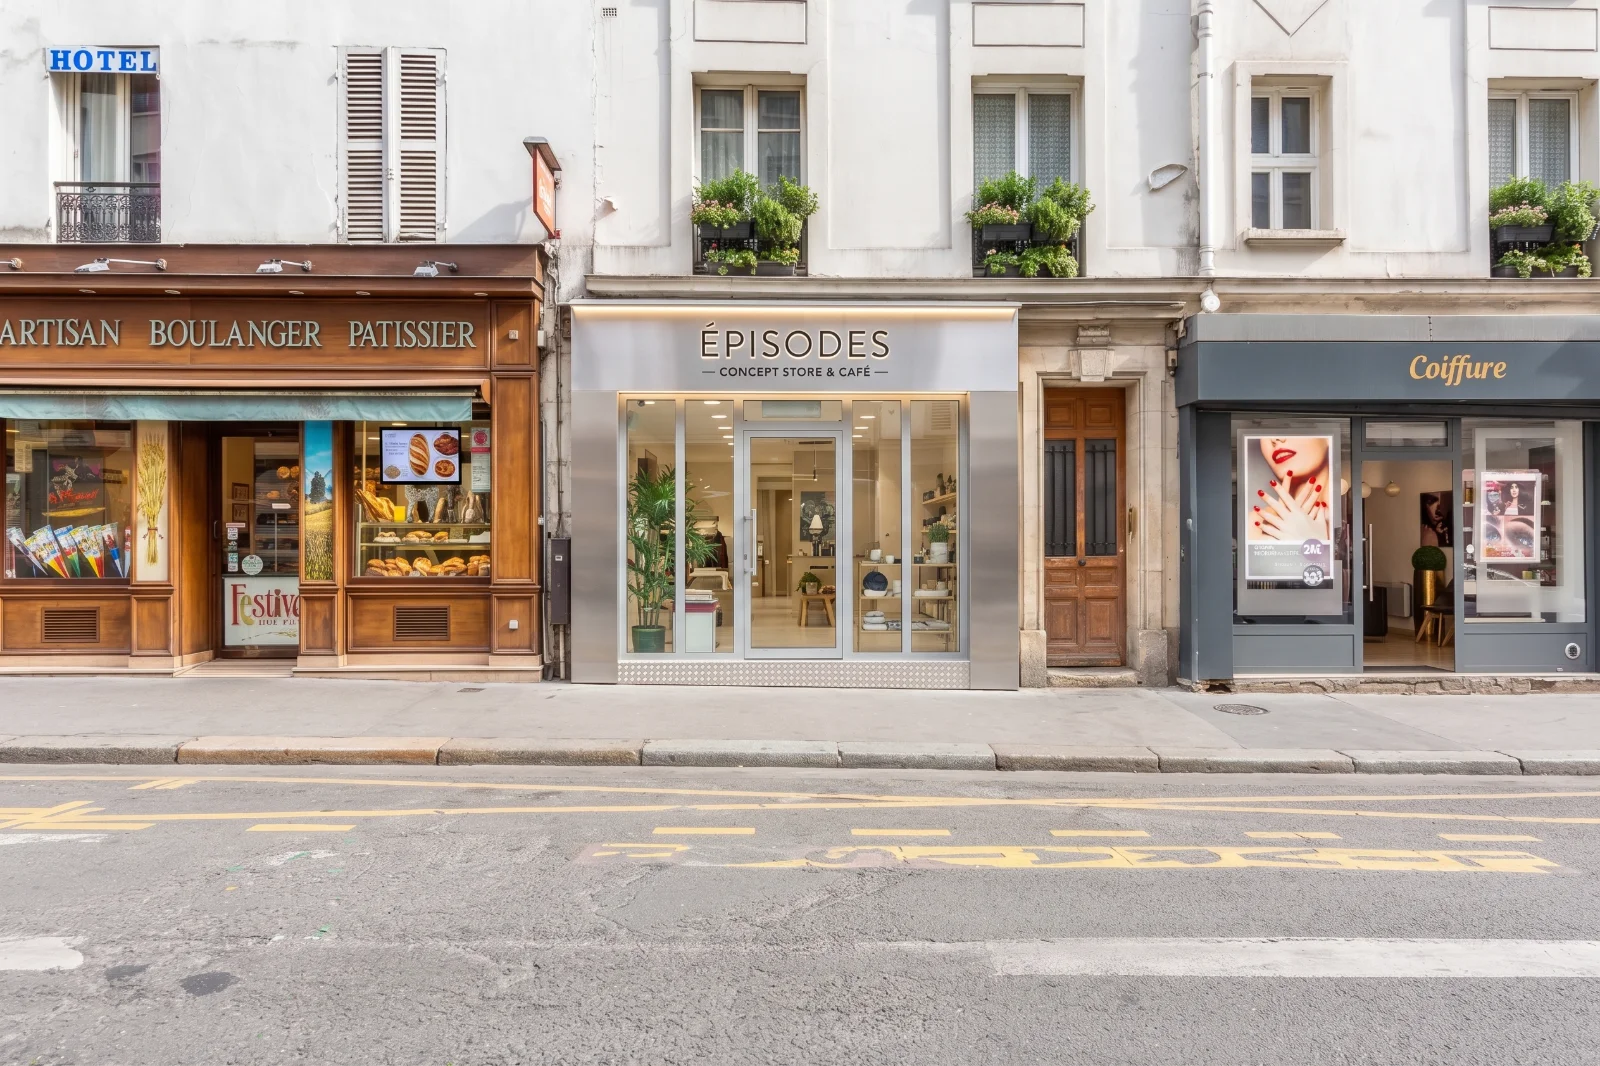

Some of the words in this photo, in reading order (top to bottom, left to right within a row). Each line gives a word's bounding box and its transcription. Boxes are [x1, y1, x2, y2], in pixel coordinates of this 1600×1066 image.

[0, 318, 121, 346] ARTISAN
[149, 319, 322, 347] BOULANGER
[348, 320, 477, 348] PATISSIER
[701, 322, 890, 358] ÉPISODES
[719, 367, 779, 377] CONCEPT
[783, 367, 822, 377] STORE
[826, 367, 835, 377] &
[838, 365, 871, 377] CAFÉ
[1409, 354, 1507, 386] Coiffure
